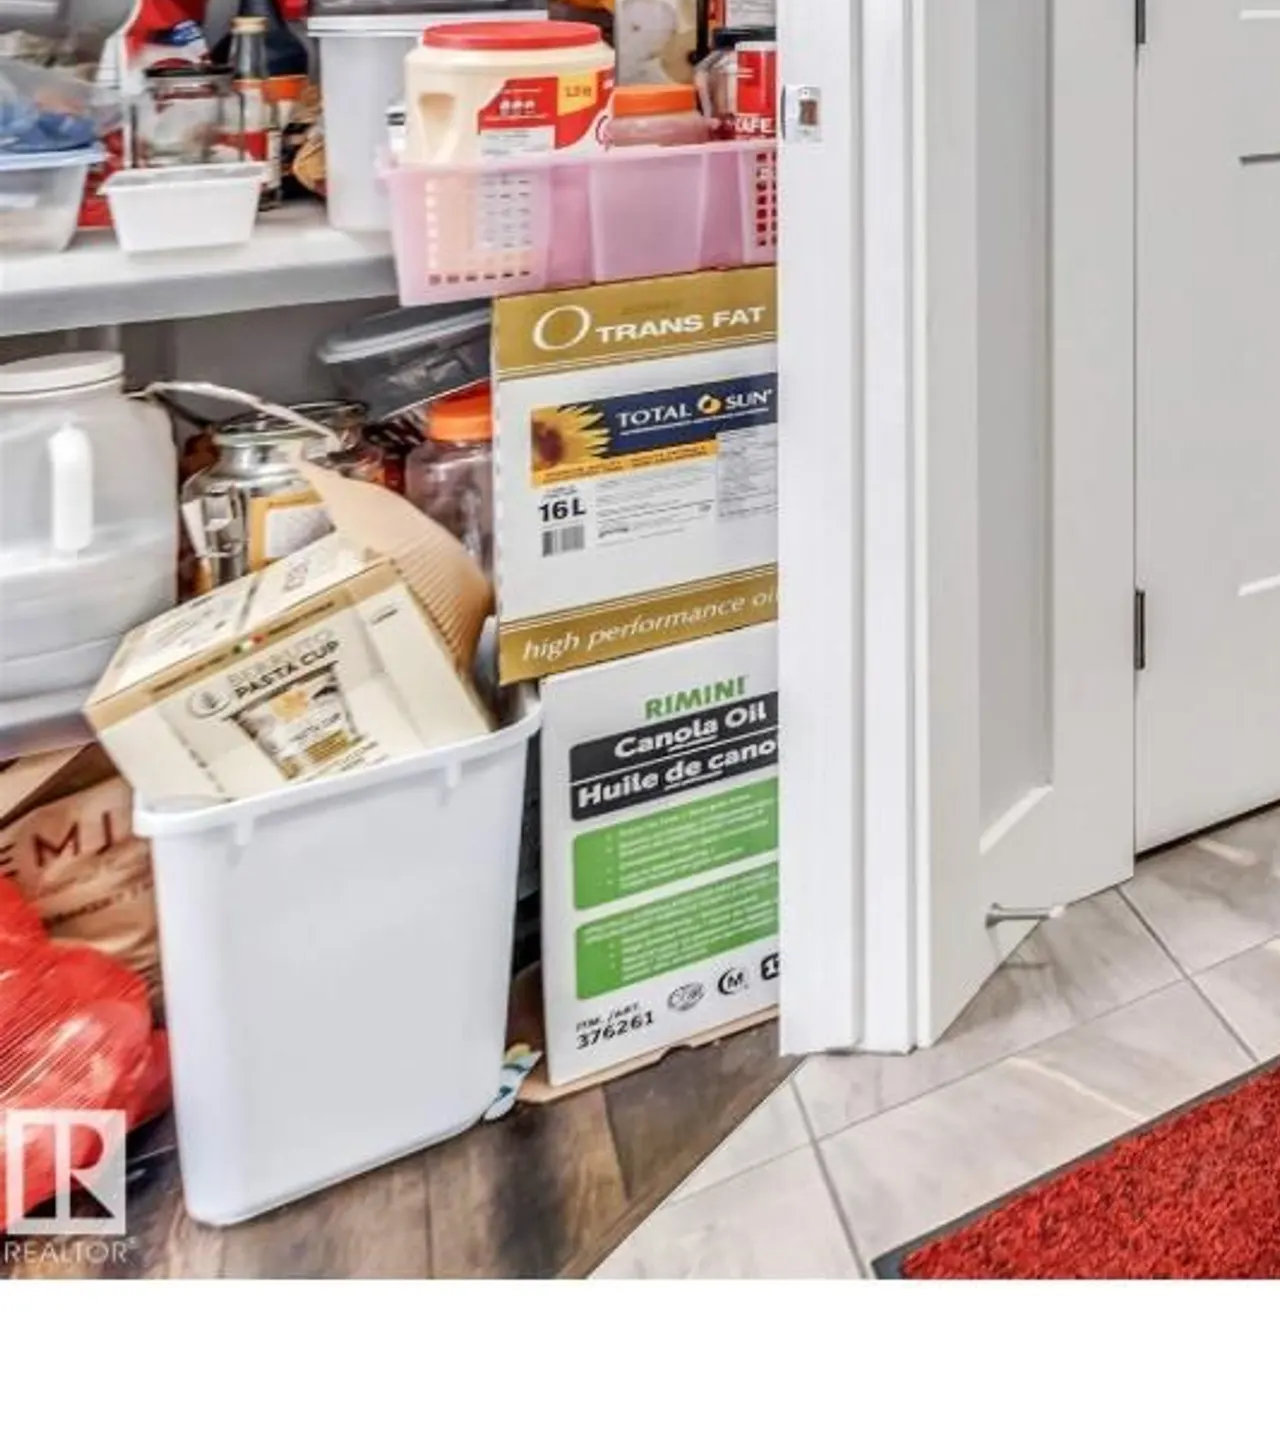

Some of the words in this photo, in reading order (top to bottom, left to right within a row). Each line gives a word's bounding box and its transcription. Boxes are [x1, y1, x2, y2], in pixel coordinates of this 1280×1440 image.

[596, 313, 704, 344] TRANS
[712, 306, 767, 328] FAT
[617, 403, 691, 428] TOTAL
[522, 625, 580, 661] high
[587, 597, 746, 651] performance
[235, 659, 300, 700] PASTA
[298, 639, 340, 671] CUP
[644, 676, 747, 720] RIMINI
[614, 718, 719, 759] Canola
[724, 701, 768, 728] Oil
[578, 771, 659, 808] Huile
[664, 760, 703, 783] de
[708, 740, 778, 771] cano
[576, 1010, 656, 1050] 376261
